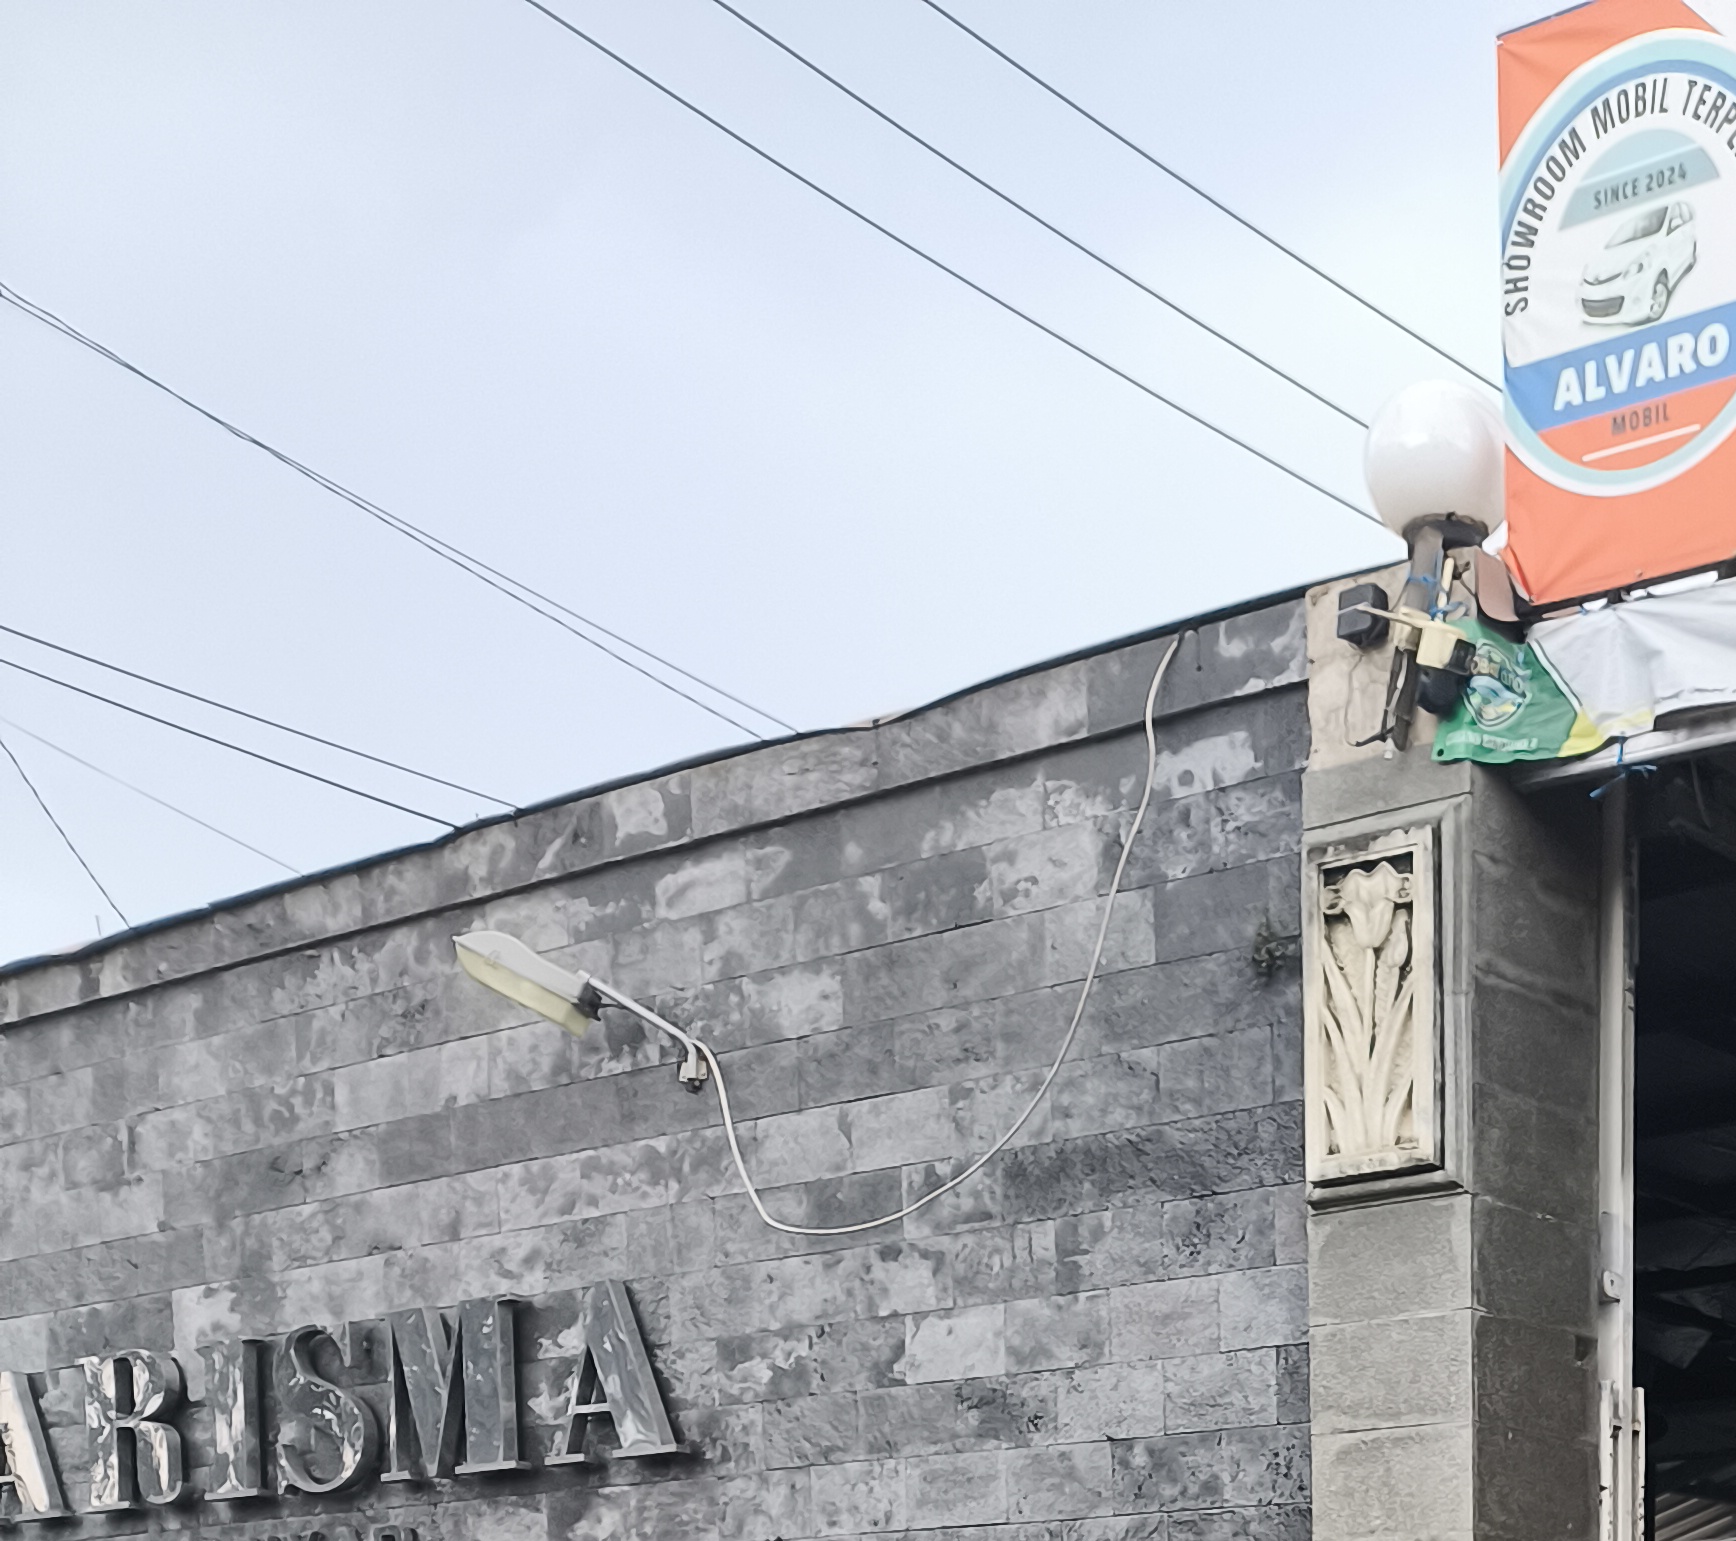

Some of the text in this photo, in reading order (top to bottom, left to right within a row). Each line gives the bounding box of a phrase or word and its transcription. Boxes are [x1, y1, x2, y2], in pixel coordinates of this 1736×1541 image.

[1504, 127, 1587, 317] SHOWROOM
[1590, 78, 1669, 140] MOBIL
[1593, 162, 1687, 210] SINCE 2024
[1553, 322, 1730, 411] ALVARO
[1611, 402, 1670, 436] MOBIL
